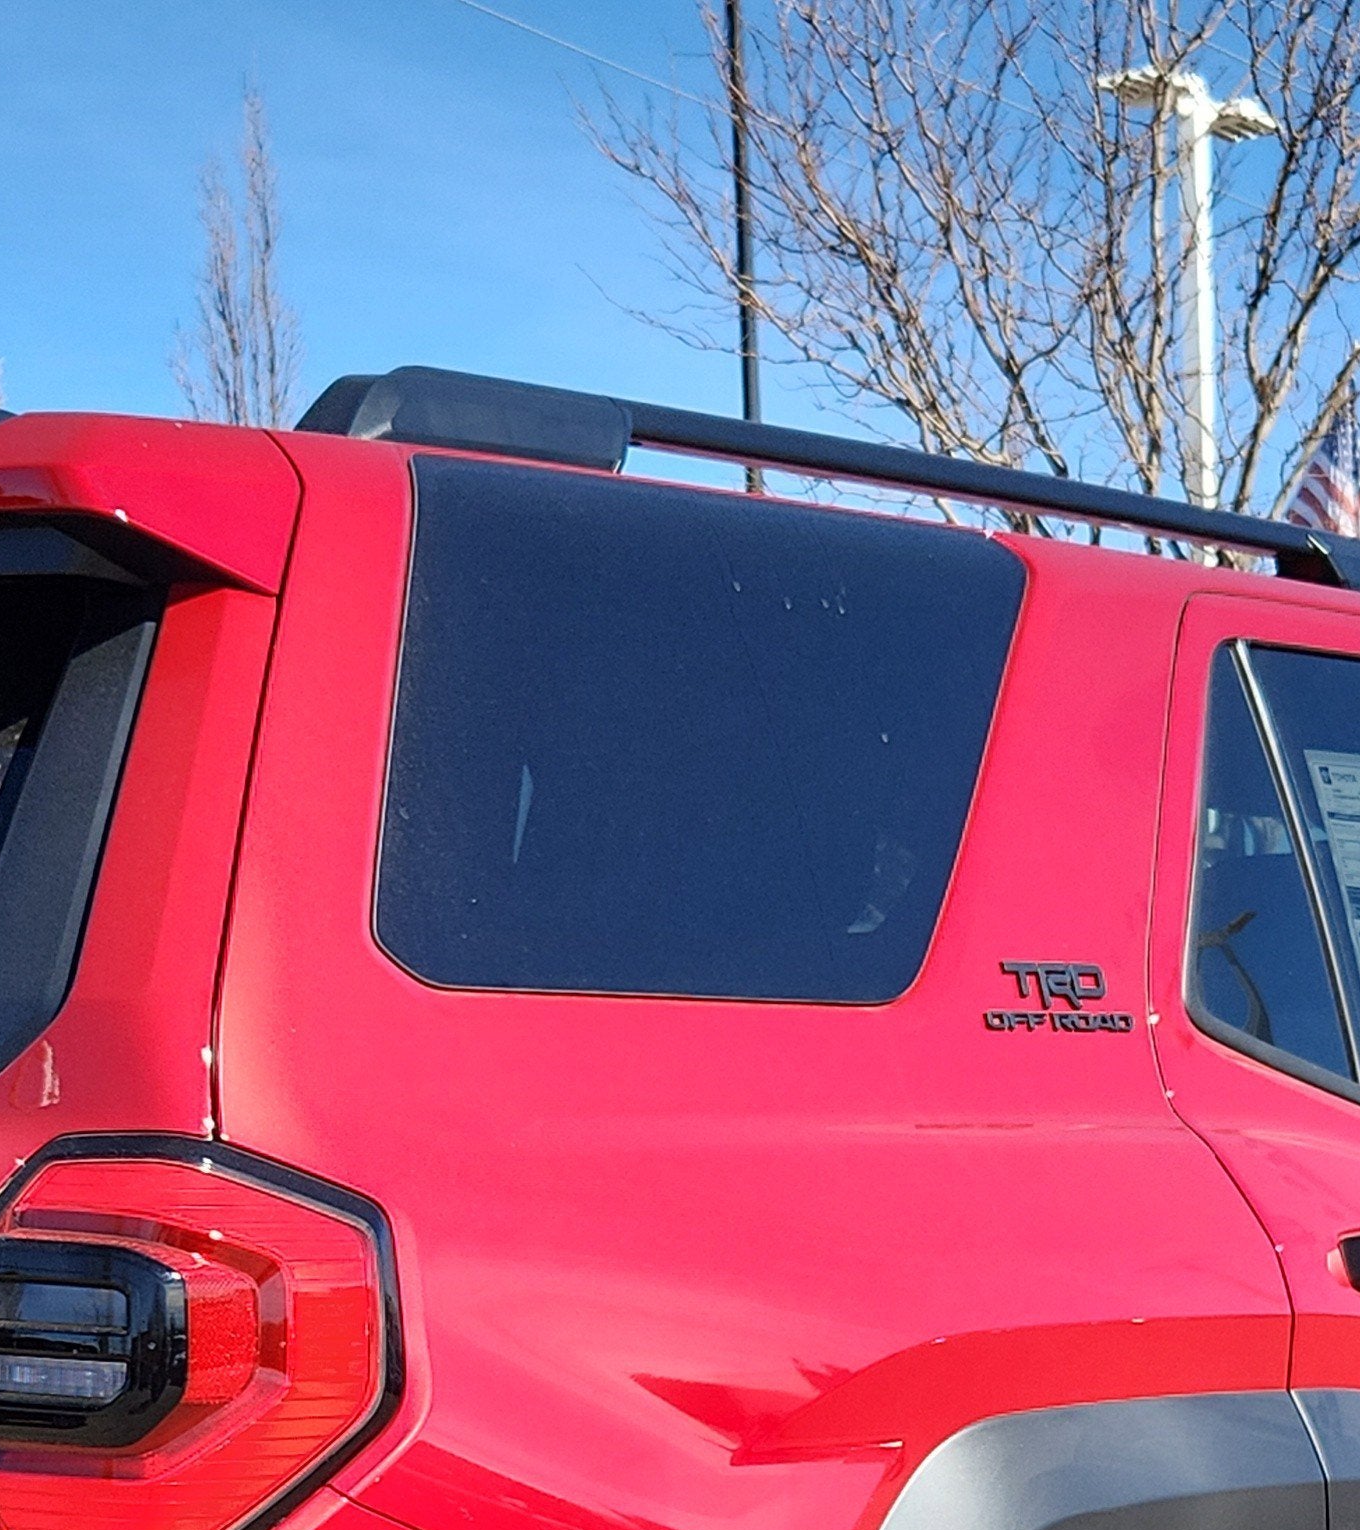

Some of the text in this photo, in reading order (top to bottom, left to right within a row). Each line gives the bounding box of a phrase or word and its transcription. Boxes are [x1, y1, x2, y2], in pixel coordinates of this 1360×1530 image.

[999, 959, 1107, 1010] TRD
[983, 1008, 1134, 1033] OFF ROAD
